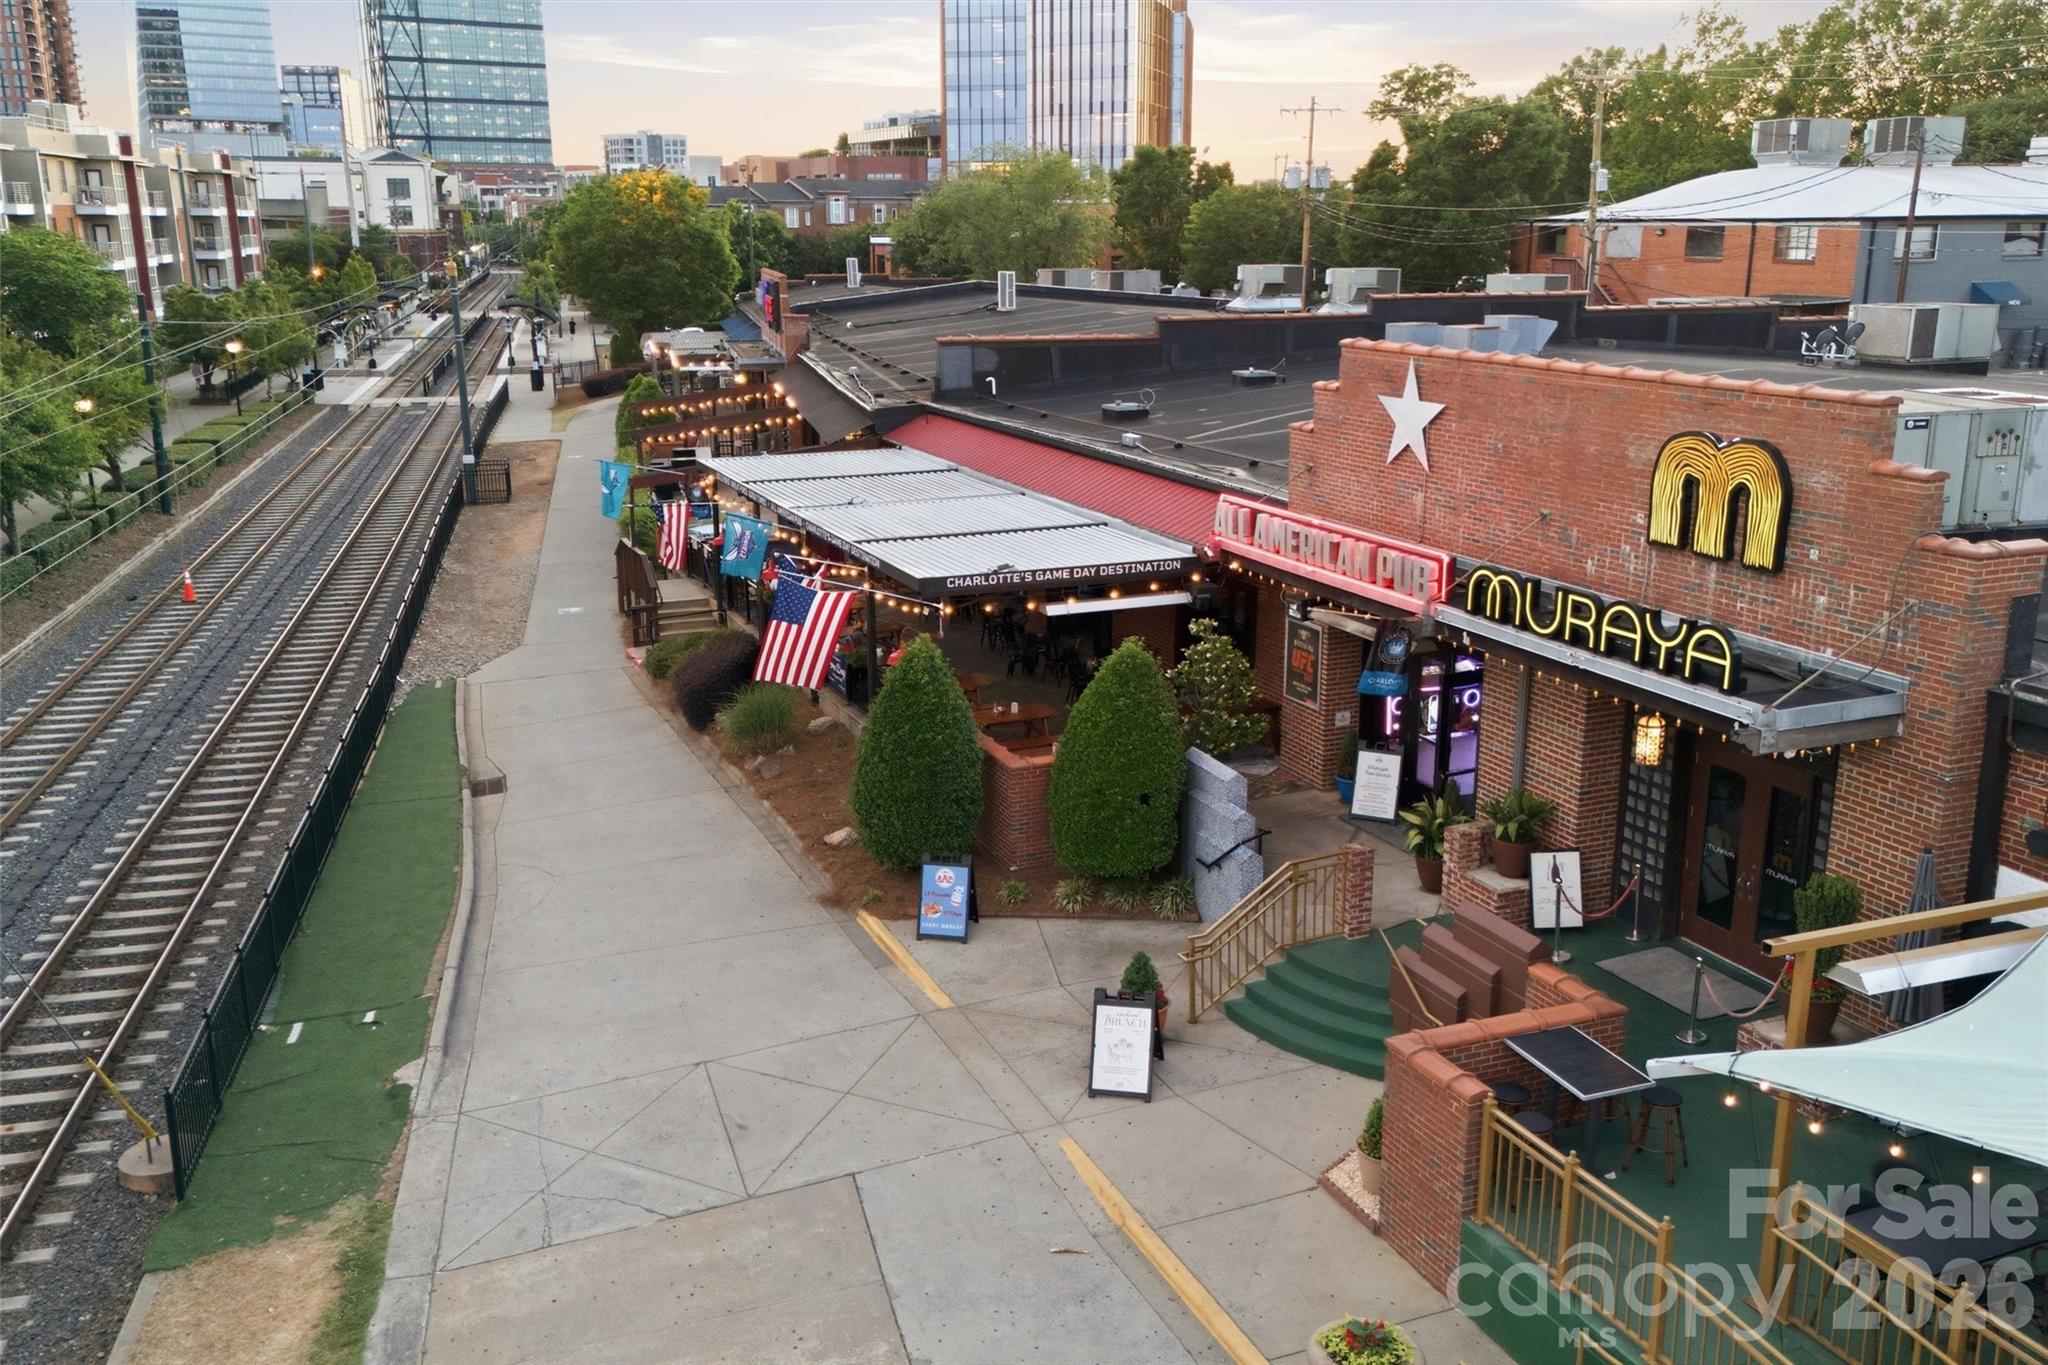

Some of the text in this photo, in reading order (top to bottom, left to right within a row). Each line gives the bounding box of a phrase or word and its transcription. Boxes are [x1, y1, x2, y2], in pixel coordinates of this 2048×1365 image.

[947, 560, 1181, 588] CHARLOTTE'S GAME DAY DESTINATION
[1214, 502, 1438, 599] ALL AMERICAN PUB
[1466, 566, 1740, 693] MURAYA
[1104, 1015, 1146, 1029] BRUNCH
